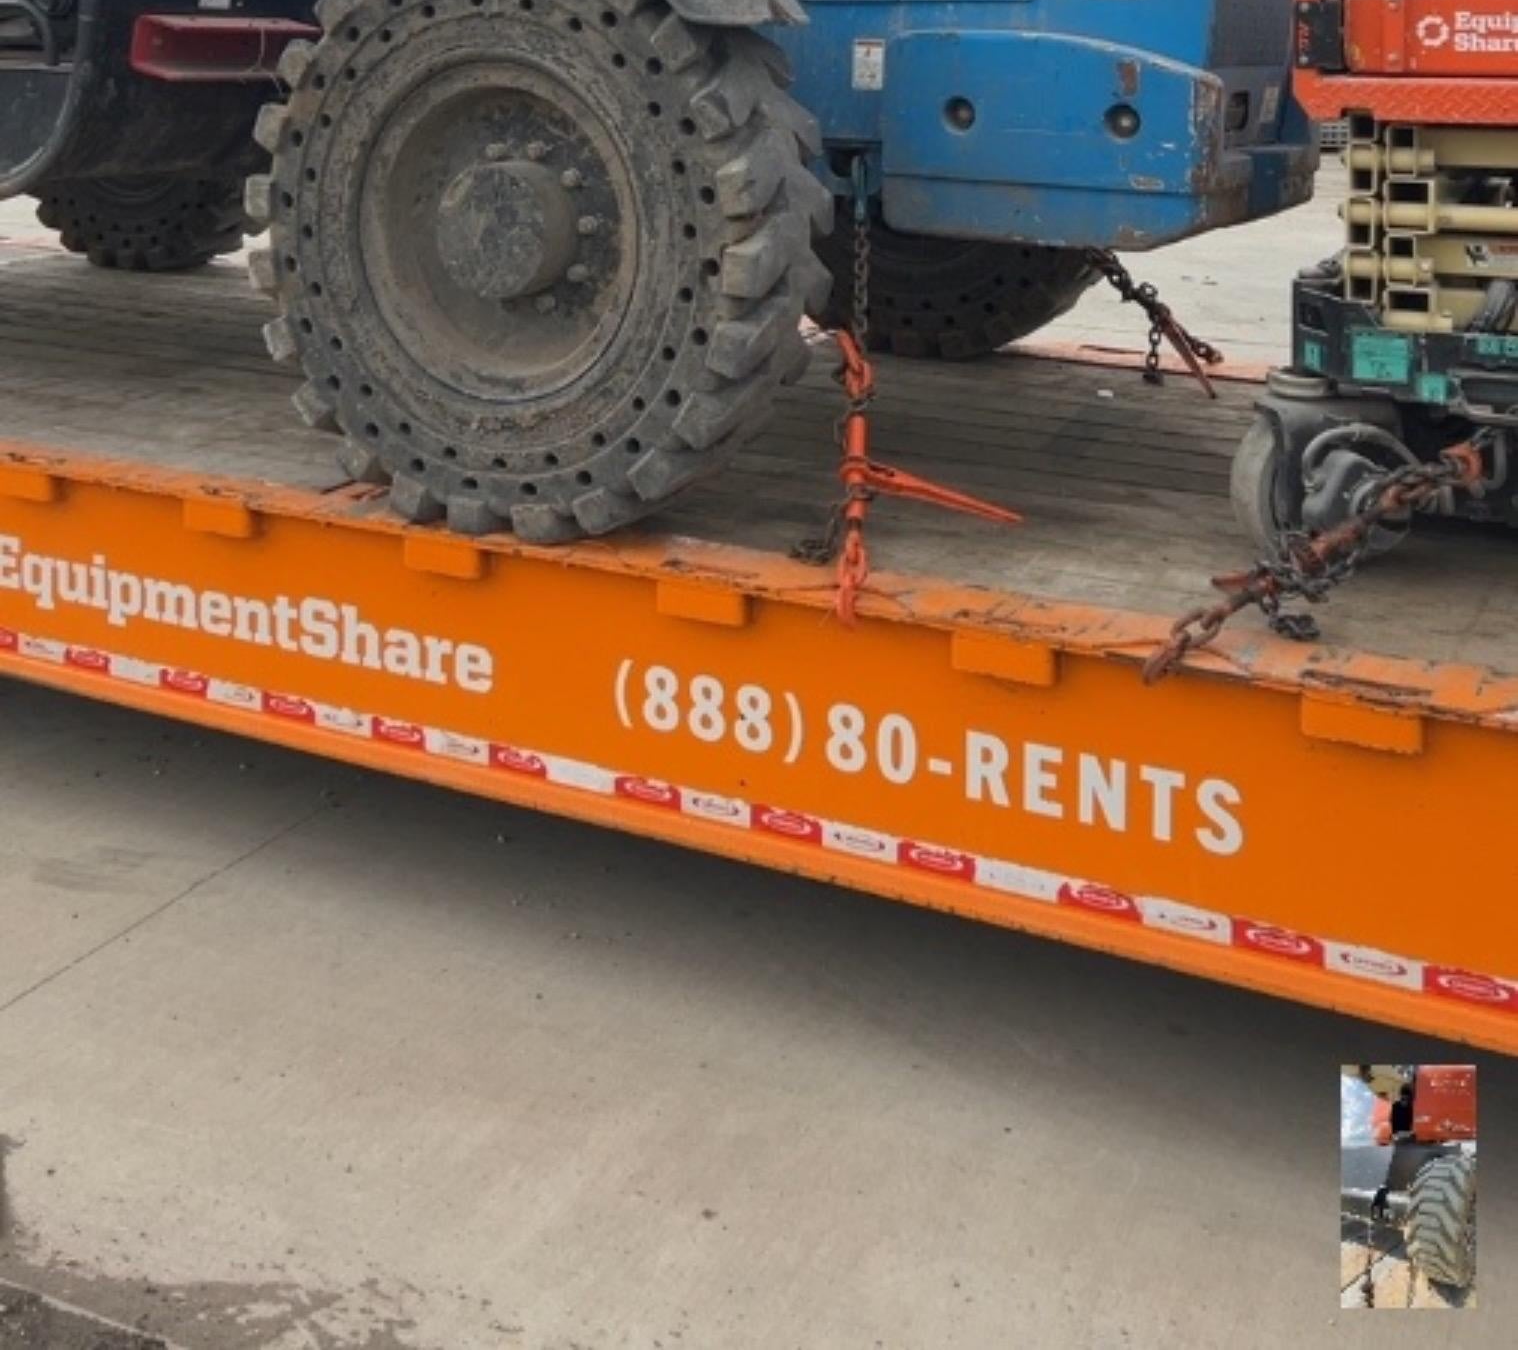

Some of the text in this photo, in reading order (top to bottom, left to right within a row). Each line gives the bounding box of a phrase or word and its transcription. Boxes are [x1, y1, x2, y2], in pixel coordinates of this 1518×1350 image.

[1454, 32, 1518, 52] Shar
[0, 532, 494, 694] EquipmentShare
[614, 658, 1244, 857] (888) 80-RENTS
